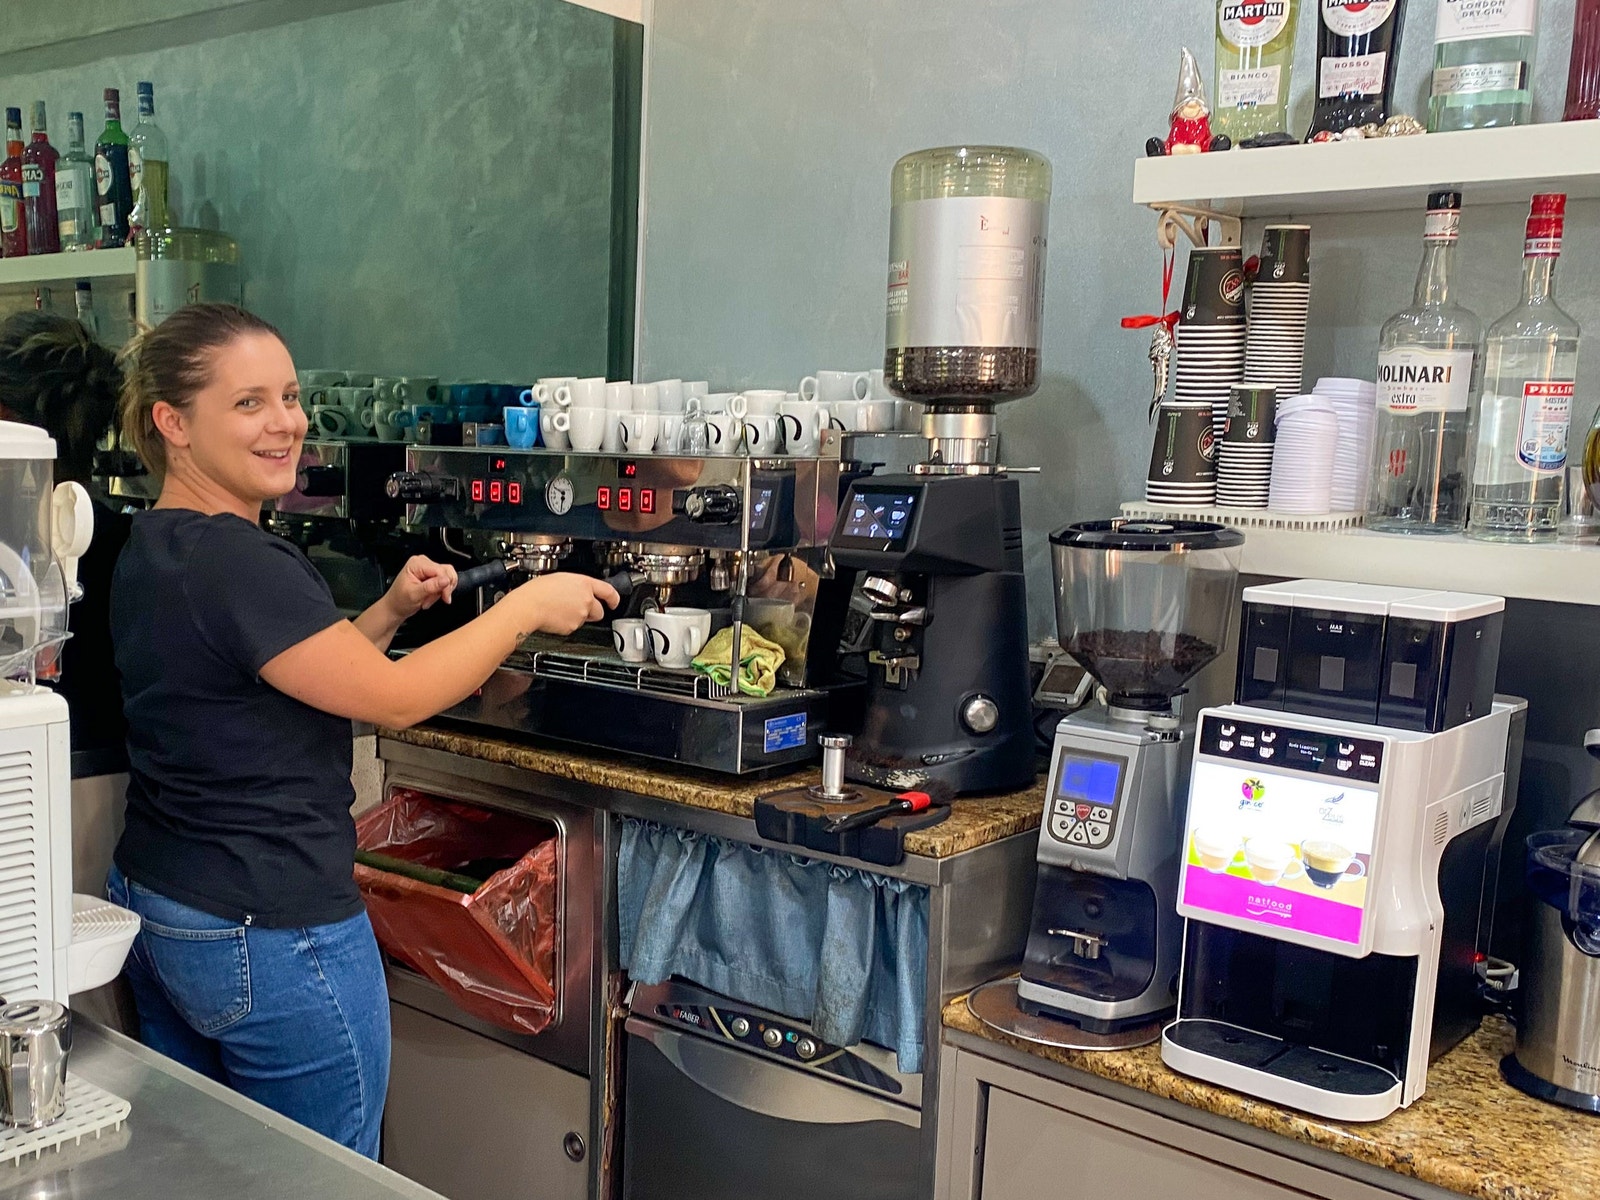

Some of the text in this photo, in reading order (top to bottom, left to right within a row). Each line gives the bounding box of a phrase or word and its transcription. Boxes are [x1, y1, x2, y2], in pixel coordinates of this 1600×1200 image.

[1224, 3, 1283, 20] MARTINI
[1334, 60, 1370, 69] ROSSO
[1230, 72, 1268, 80] BIANCO
[1391, 393, 1416, 404] extra
[1248, 895, 1292, 911] natfood
[679, 1010, 700, 1024] FABER
